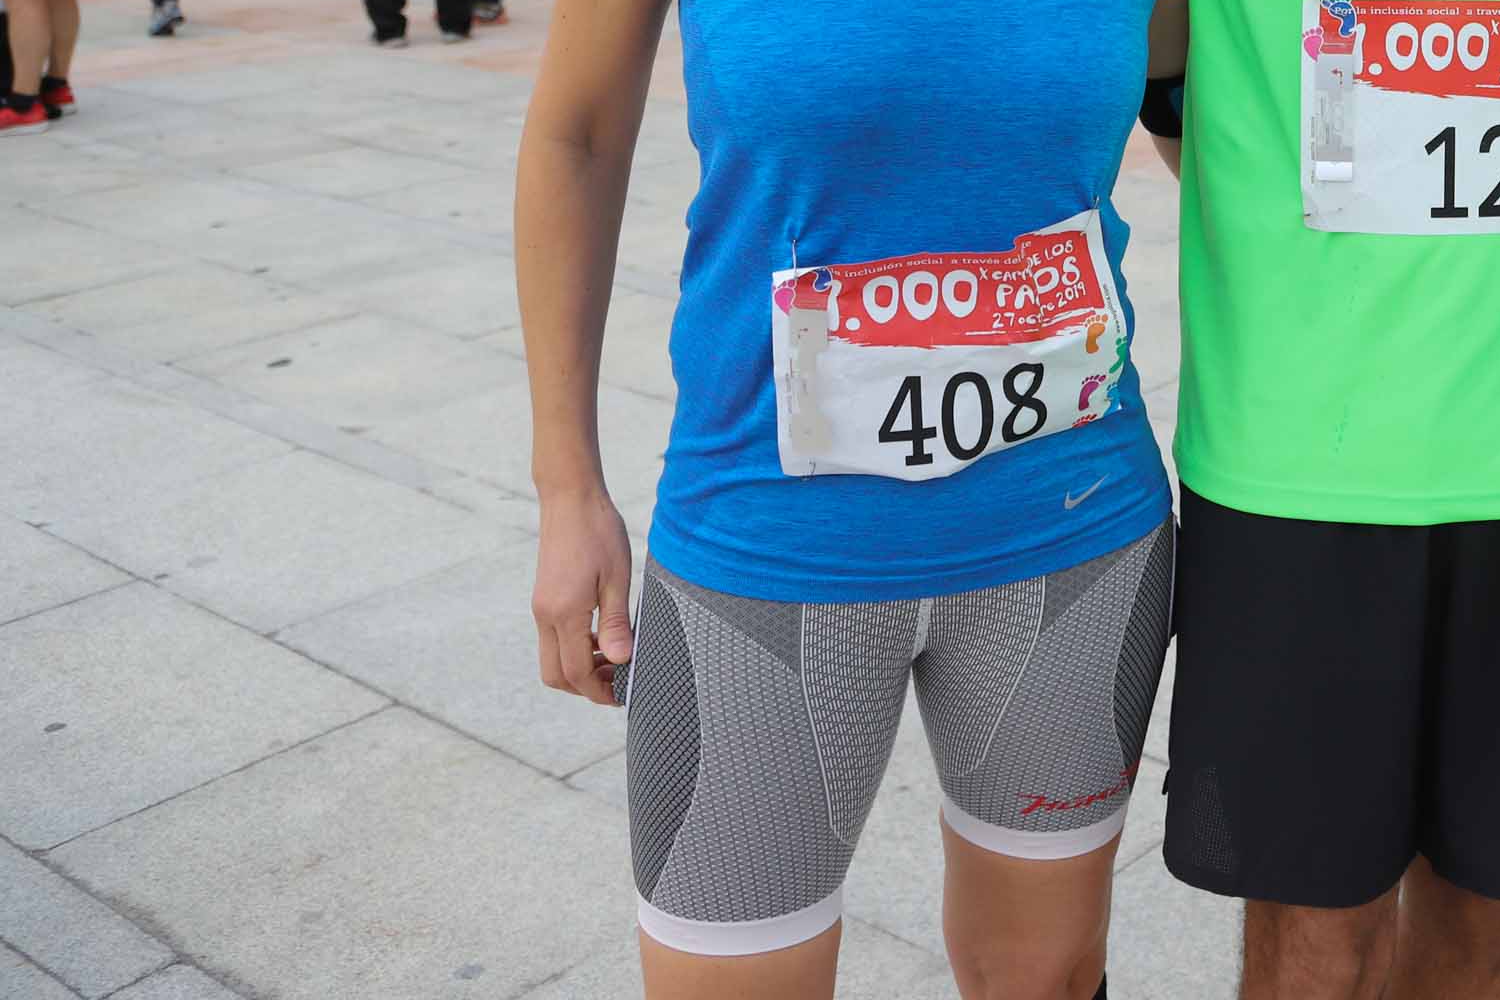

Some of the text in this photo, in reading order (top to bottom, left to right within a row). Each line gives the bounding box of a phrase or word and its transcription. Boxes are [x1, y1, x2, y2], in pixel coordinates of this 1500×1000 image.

[1356, 6, 1367, 16] la
[1370, 6, 1424, 16] inclusión
[1426, 6, 1460, 16] social
[1466, 8, 1473, 16] a
[1491, 19, 1500, 36] X
[1349, 22, 1490, 76] 1.000
[844, 261, 903, 278] inclusión
[906, 257, 944, 266] social
[962, 257, 1000, 265] través
[1003, 256, 1022, 265] del
[979, 267, 989, 281] X
[1044, 239, 1074, 261] LOS
[996, 256, 1081, 310] PAOS
[825, 268, 978, 332] 1.000
[992, 311, 1015, 329] 27
[1056, 281, 1087, 308] 2019
[878, 362, 1048, 467] 408
